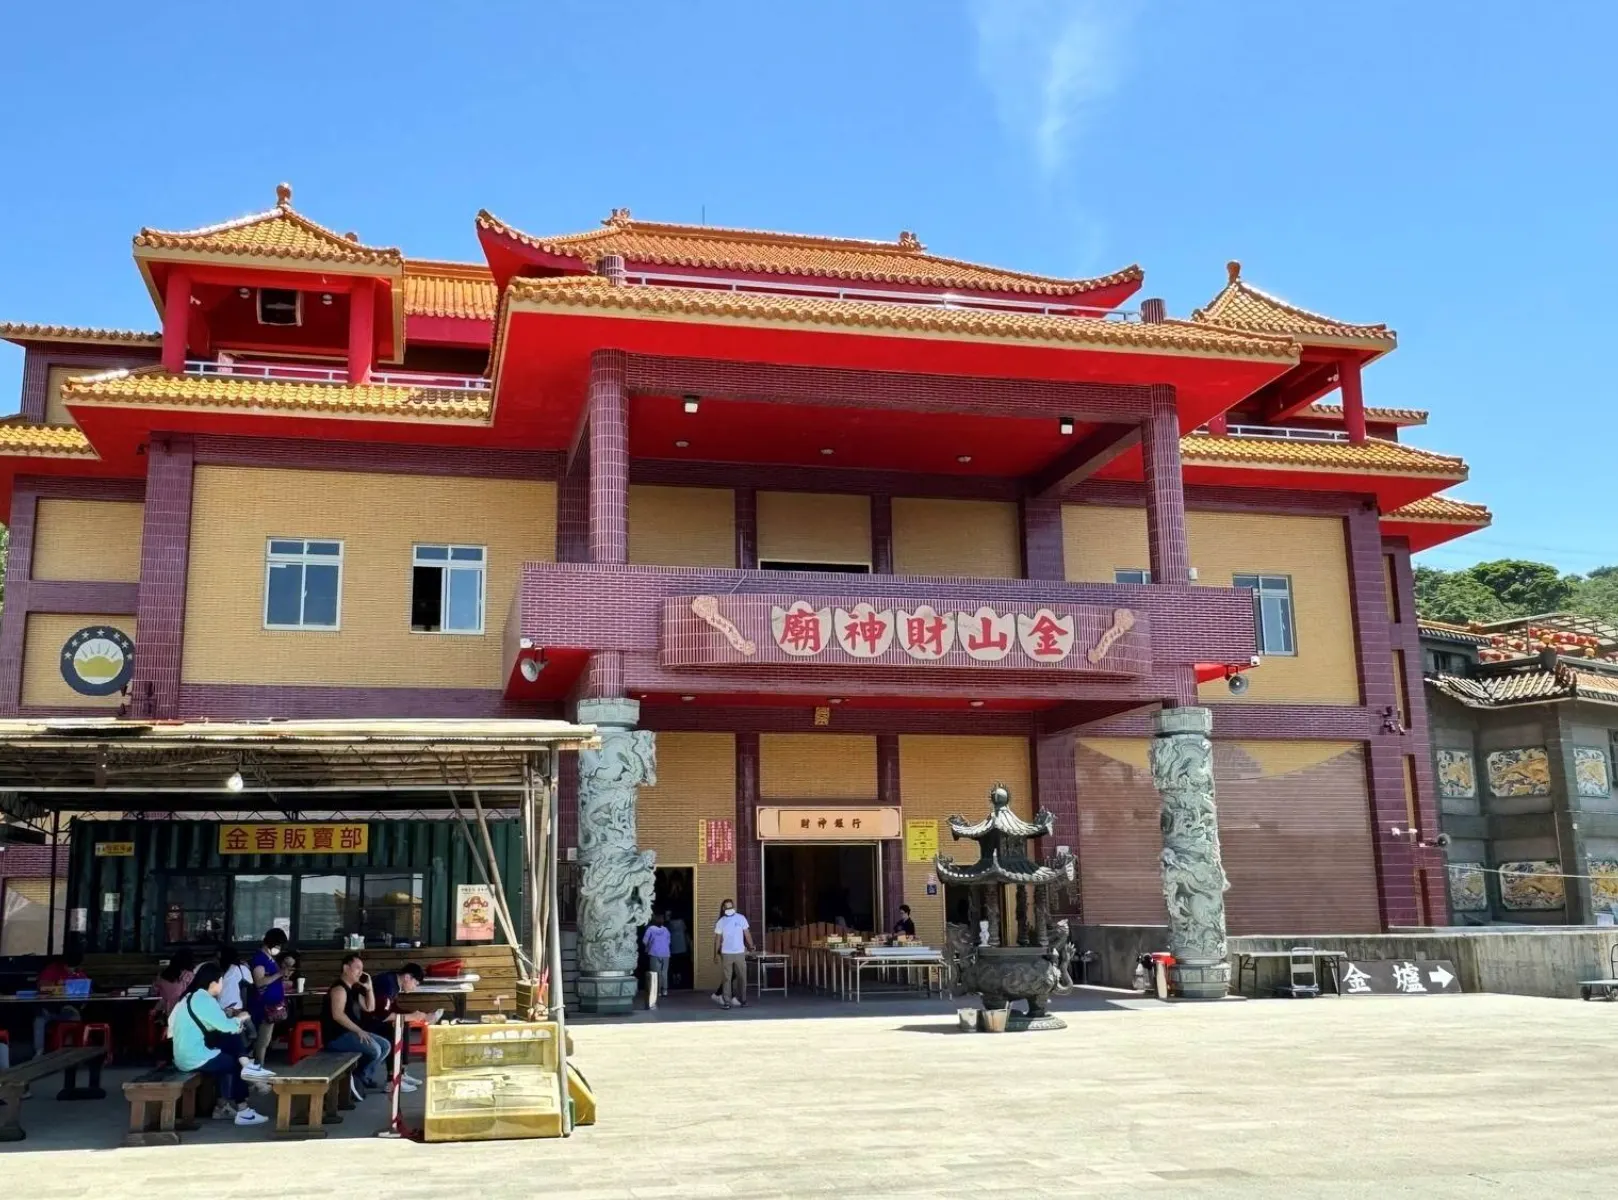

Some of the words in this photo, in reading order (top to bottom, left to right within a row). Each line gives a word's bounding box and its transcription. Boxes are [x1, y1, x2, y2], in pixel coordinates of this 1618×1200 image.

[225, 827, 362, 850] 金香販賣部
[1342, 961, 1428, 993] 金爐
